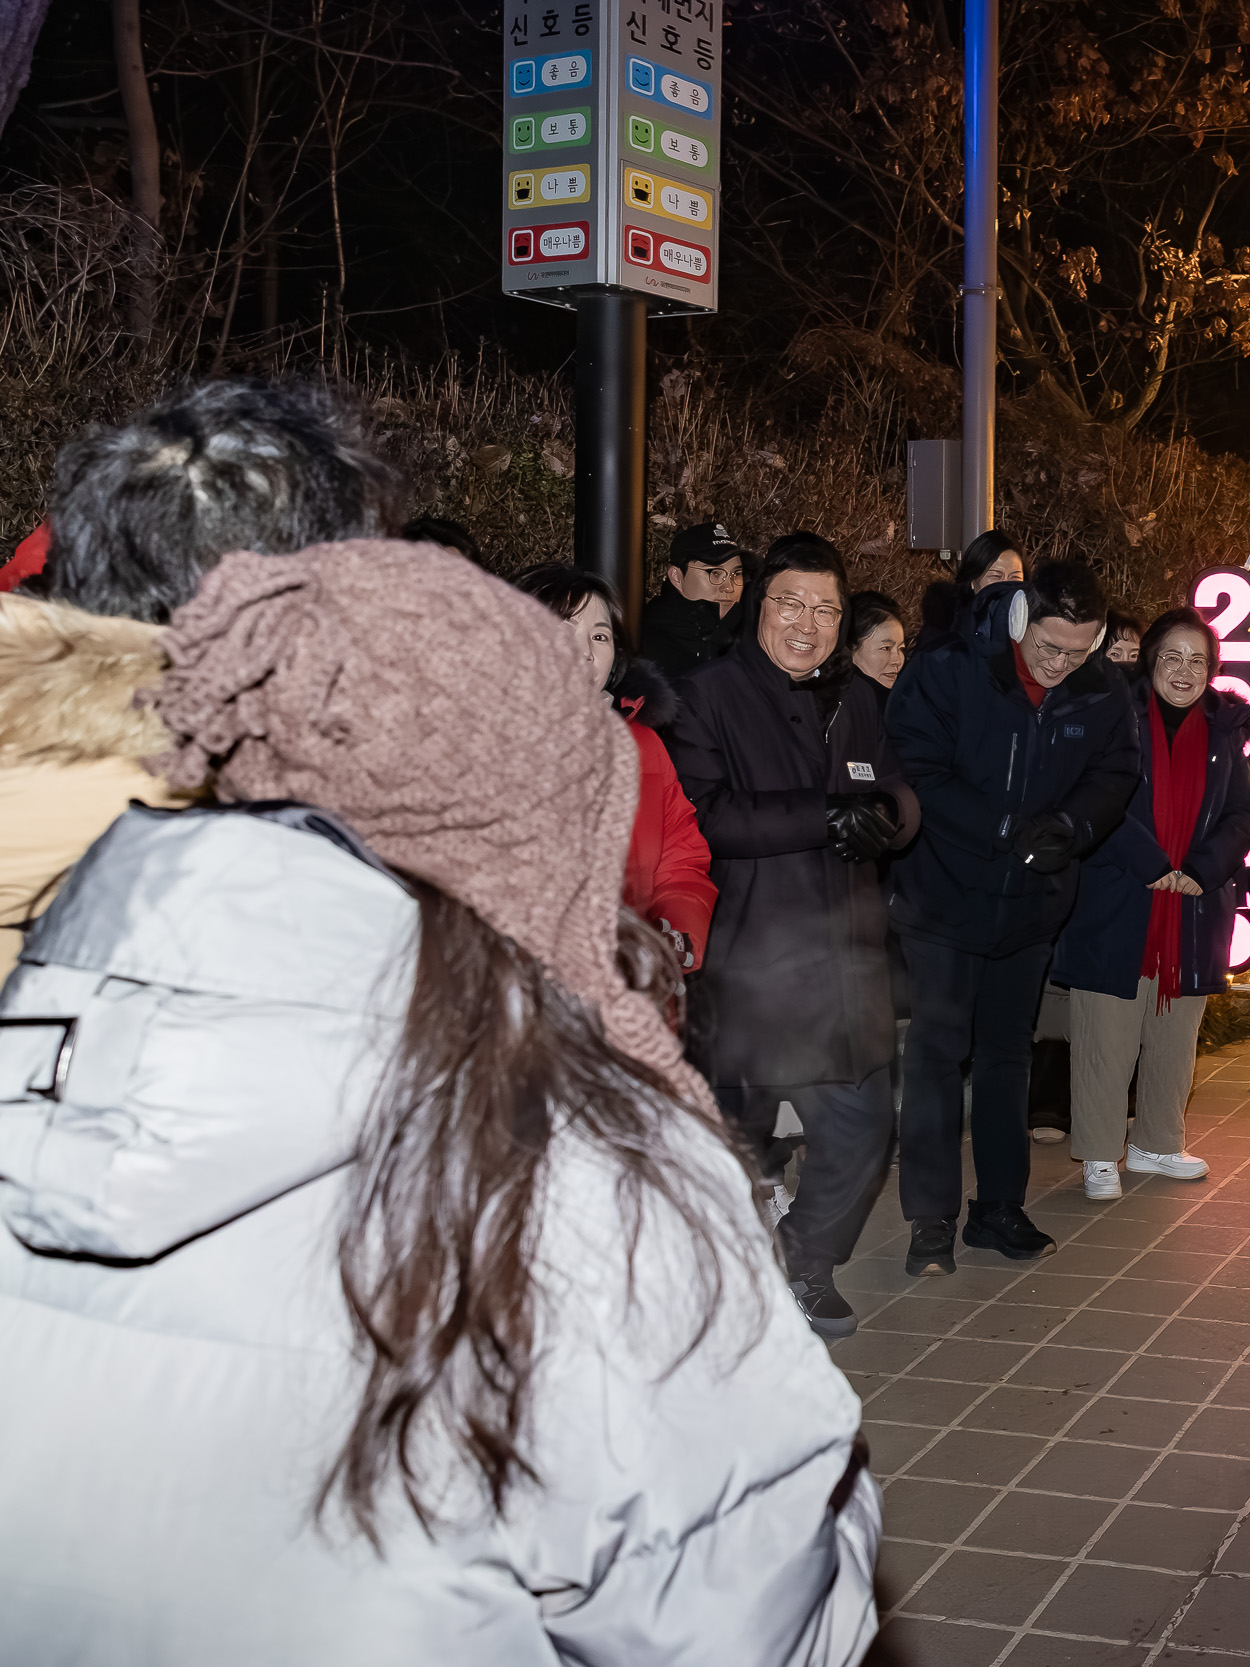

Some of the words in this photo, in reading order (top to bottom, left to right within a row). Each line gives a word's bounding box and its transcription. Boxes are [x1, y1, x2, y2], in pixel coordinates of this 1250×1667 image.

[510, 4, 593, 47] 신호등
[641, 0, 714, 33] 먼지
[626, 10, 715, 71] 신호등
[548, 60, 580, 81] 좋음
[669, 80, 702, 106] 좋음
[548, 119, 579, 137] 보통
[669, 138, 701, 162] 보통
[547, 176, 579, 194] 나쁨
[668, 194, 701, 217] 나쁨
[543, 234, 582, 250] 매우나쁨
[664, 248, 703, 272] 매우나쁨
